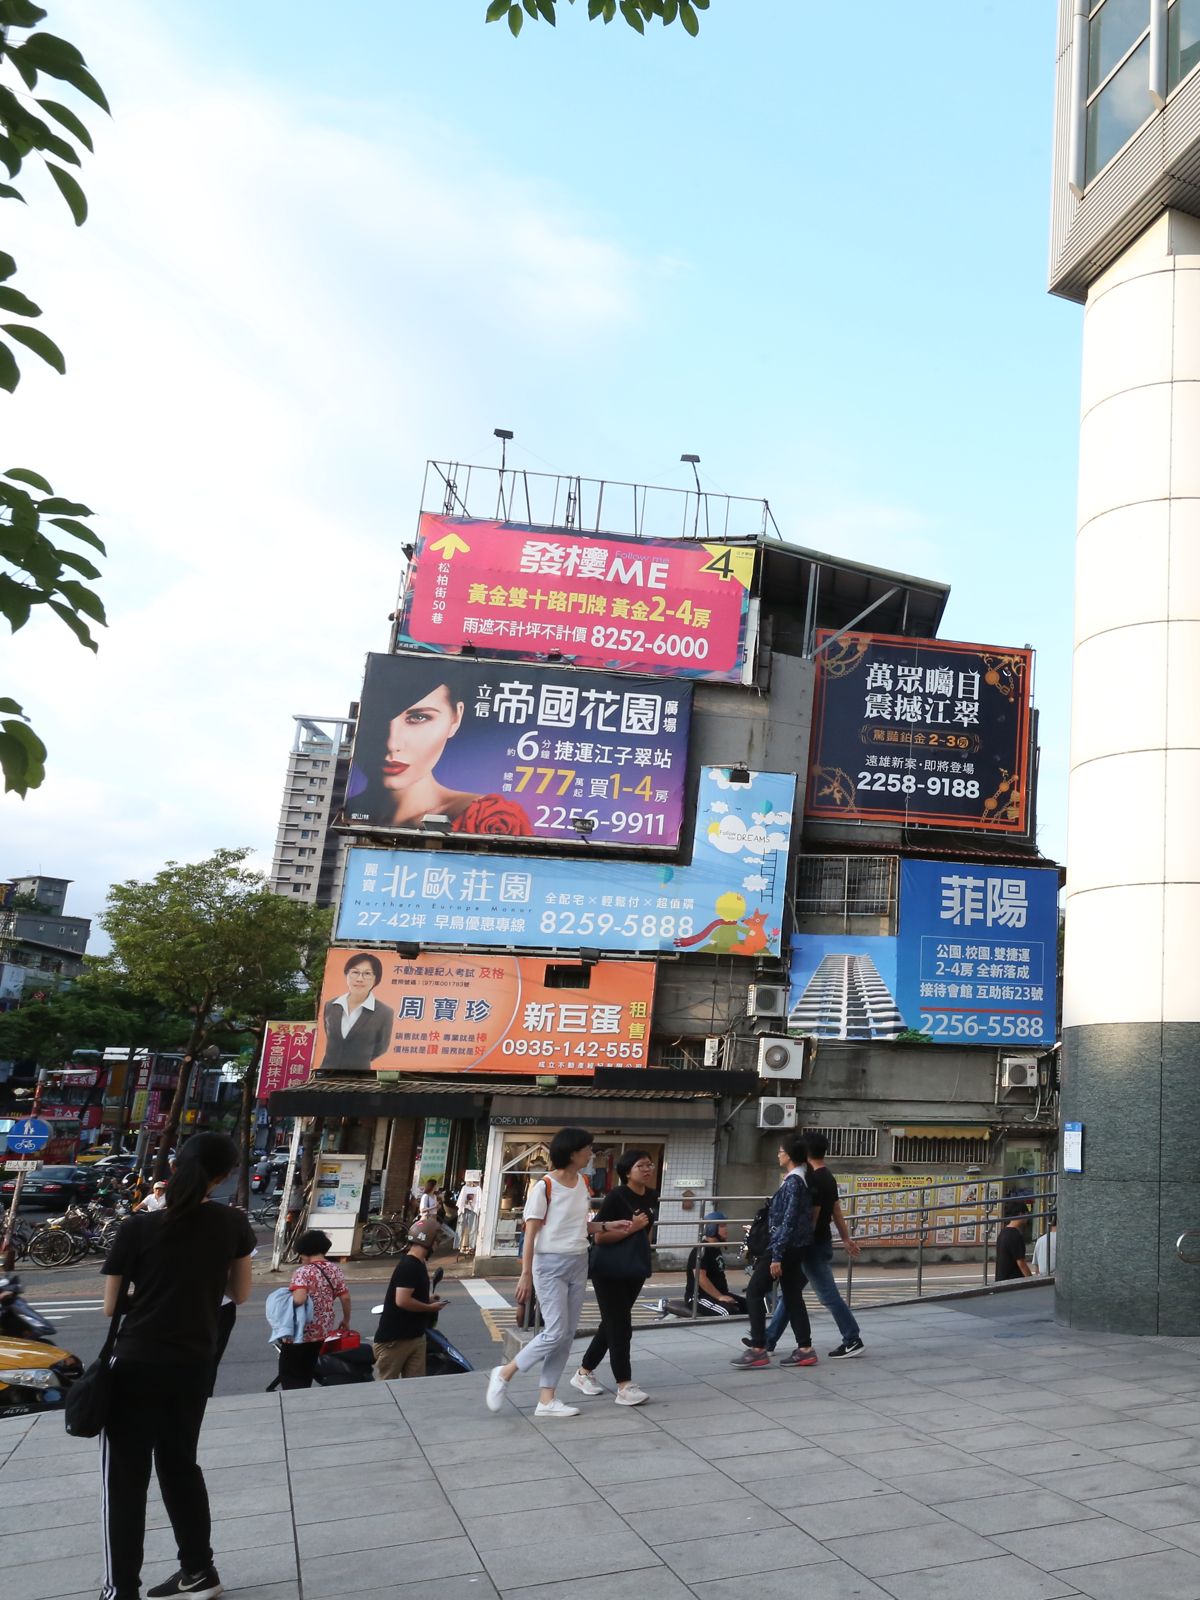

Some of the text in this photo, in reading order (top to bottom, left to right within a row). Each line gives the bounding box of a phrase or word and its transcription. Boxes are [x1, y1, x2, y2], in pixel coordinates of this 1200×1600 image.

[704, 549, 734, 578] 4
[431, 562, 450, 624] 松柏街50巷
[467, 583, 711, 629] 黃金雙十路門牌 黃金2-4房
[462, 617, 709, 659] 雨遮不計坪不計價 8252-6000
[474, 684, 493, 718] 立信
[493, 680, 663, 735] 帝國花園
[863, 693, 980, 728] 震撼江翠
[662, 700, 679, 733] 廣場
[554, 740, 673, 769] 捷運江子翠站
[857, 771, 980, 799] 2258-9188
[534, 806, 665, 836] 2256-9911
[736, 834, 770, 843] DREAMS
[381, 865, 532, 903] 北歐莊園
[355, 900, 421, 908] Northern
[432, 904, 479, 912] Europe
[940, 875, 1028, 929] 菲陽
[357, 912, 526, 933] 27-42坪 早鳥優惠專線
[540, 910, 693, 938] 8259-5888
[393, 965, 504, 979] 不動產經紀人考試 及格
[936, 962, 1030, 980] 2-4房 全新落成
[920, 982, 1044, 1001] 接待會館 互助街23號
[398, 996, 491, 1021] 周寶珍
[522, 1002, 623, 1034] 新巨蛋
[628, 1001, 647, 1040] 租售
[920, 1014, 1044, 1038] 2256-5588
[502, 1039, 643, 1058] 0935-142-555
[490, 1116, 539, 1125] KOREA LADY
